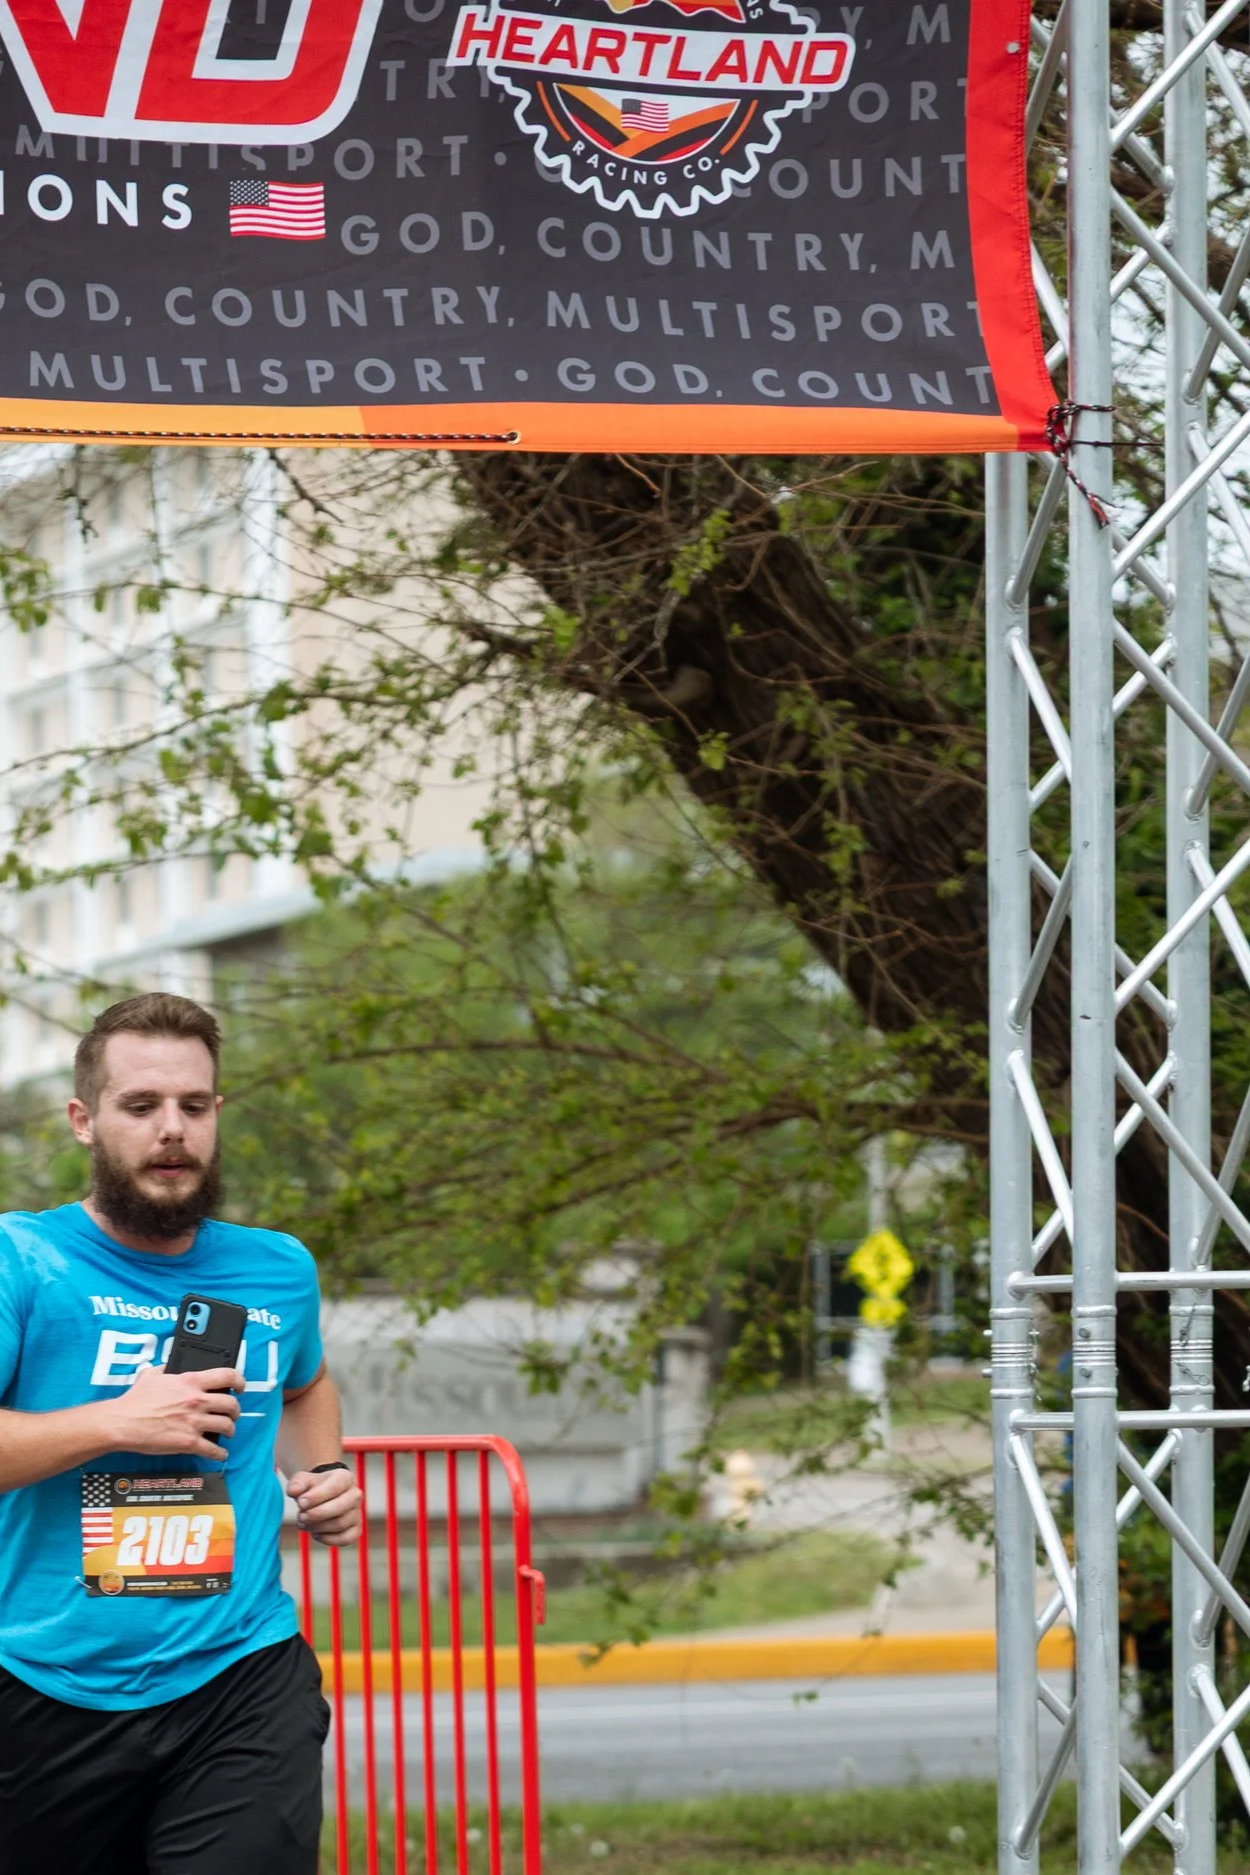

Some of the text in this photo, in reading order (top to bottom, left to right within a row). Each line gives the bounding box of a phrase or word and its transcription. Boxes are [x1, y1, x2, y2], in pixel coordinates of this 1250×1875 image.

[456, 12, 849, 85] HEARTLAND
[572, 140, 668, 185] RACING
[683, 156, 720, 178] CO.
[341, 210, 506, 256] GOD,
[537, 217, 878, 274] COUNTRY,
[164, 285, 514, 329] COUNTRY,
[29, 350, 487, 394] MULTISPORT
[88, 1296, 181, 1322] Missou
[90, 1329, 279, 1393] BU
[116, 1515, 214, 1566] 2103
